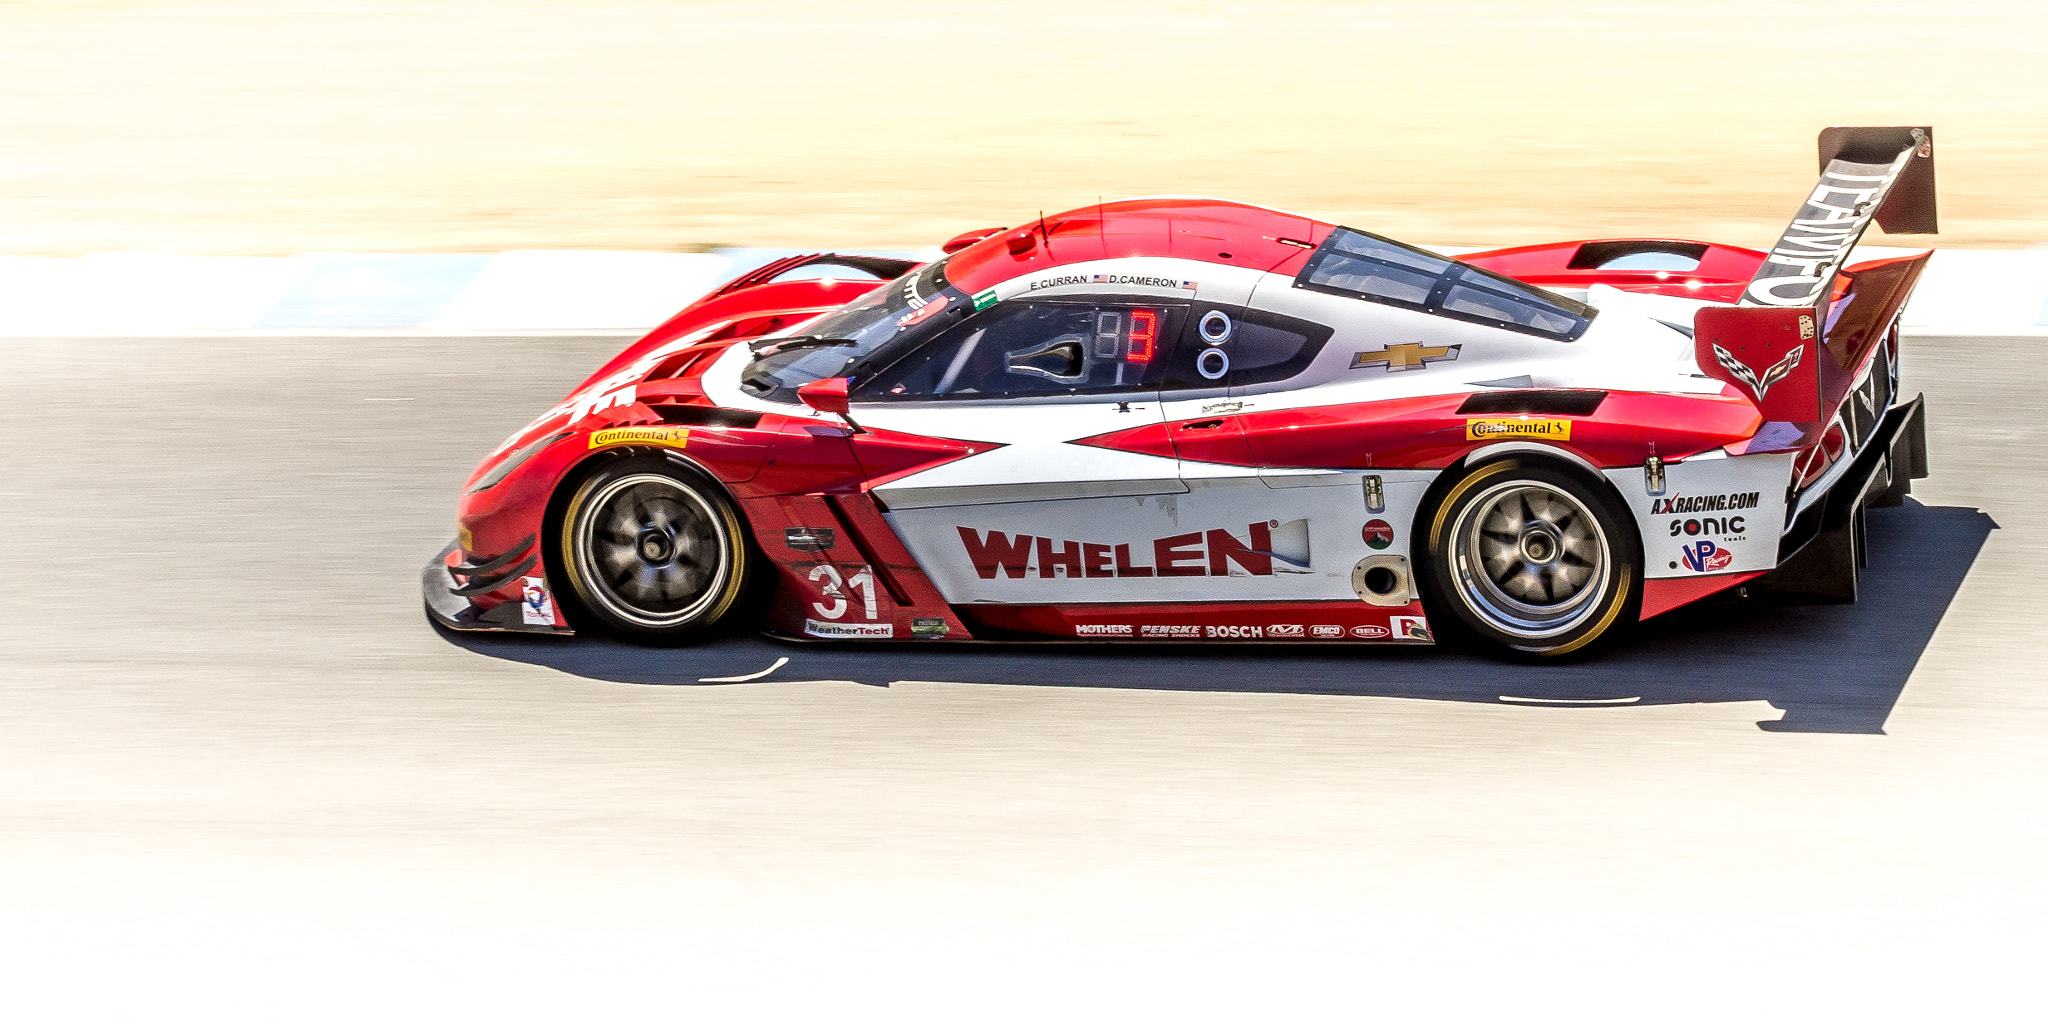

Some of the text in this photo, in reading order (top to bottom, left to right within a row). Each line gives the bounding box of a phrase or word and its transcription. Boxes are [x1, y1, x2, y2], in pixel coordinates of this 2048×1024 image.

[1030, 275, 1177, 290] E.CURRAN D.CAMERON
[1472, 421, 1552, 437] Continental
[595, 430, 669, 444] Continental
[1651, 491, 1760, 515] AXRACING.COM
[956, 521, 1273, 579] WHELEN
[1682, 540, 1716, 572] VP
[808, 564, 878, 620] 31
[808, 623, 890, 635] WeatherTech
[1075, 624, 1133, 634] MOTHERS
[1140, 625, 1201, 634] PENSKE
[1205, 625, 1263, 638] BOSCH
[1313, 626, 1340, 635] EMCO
